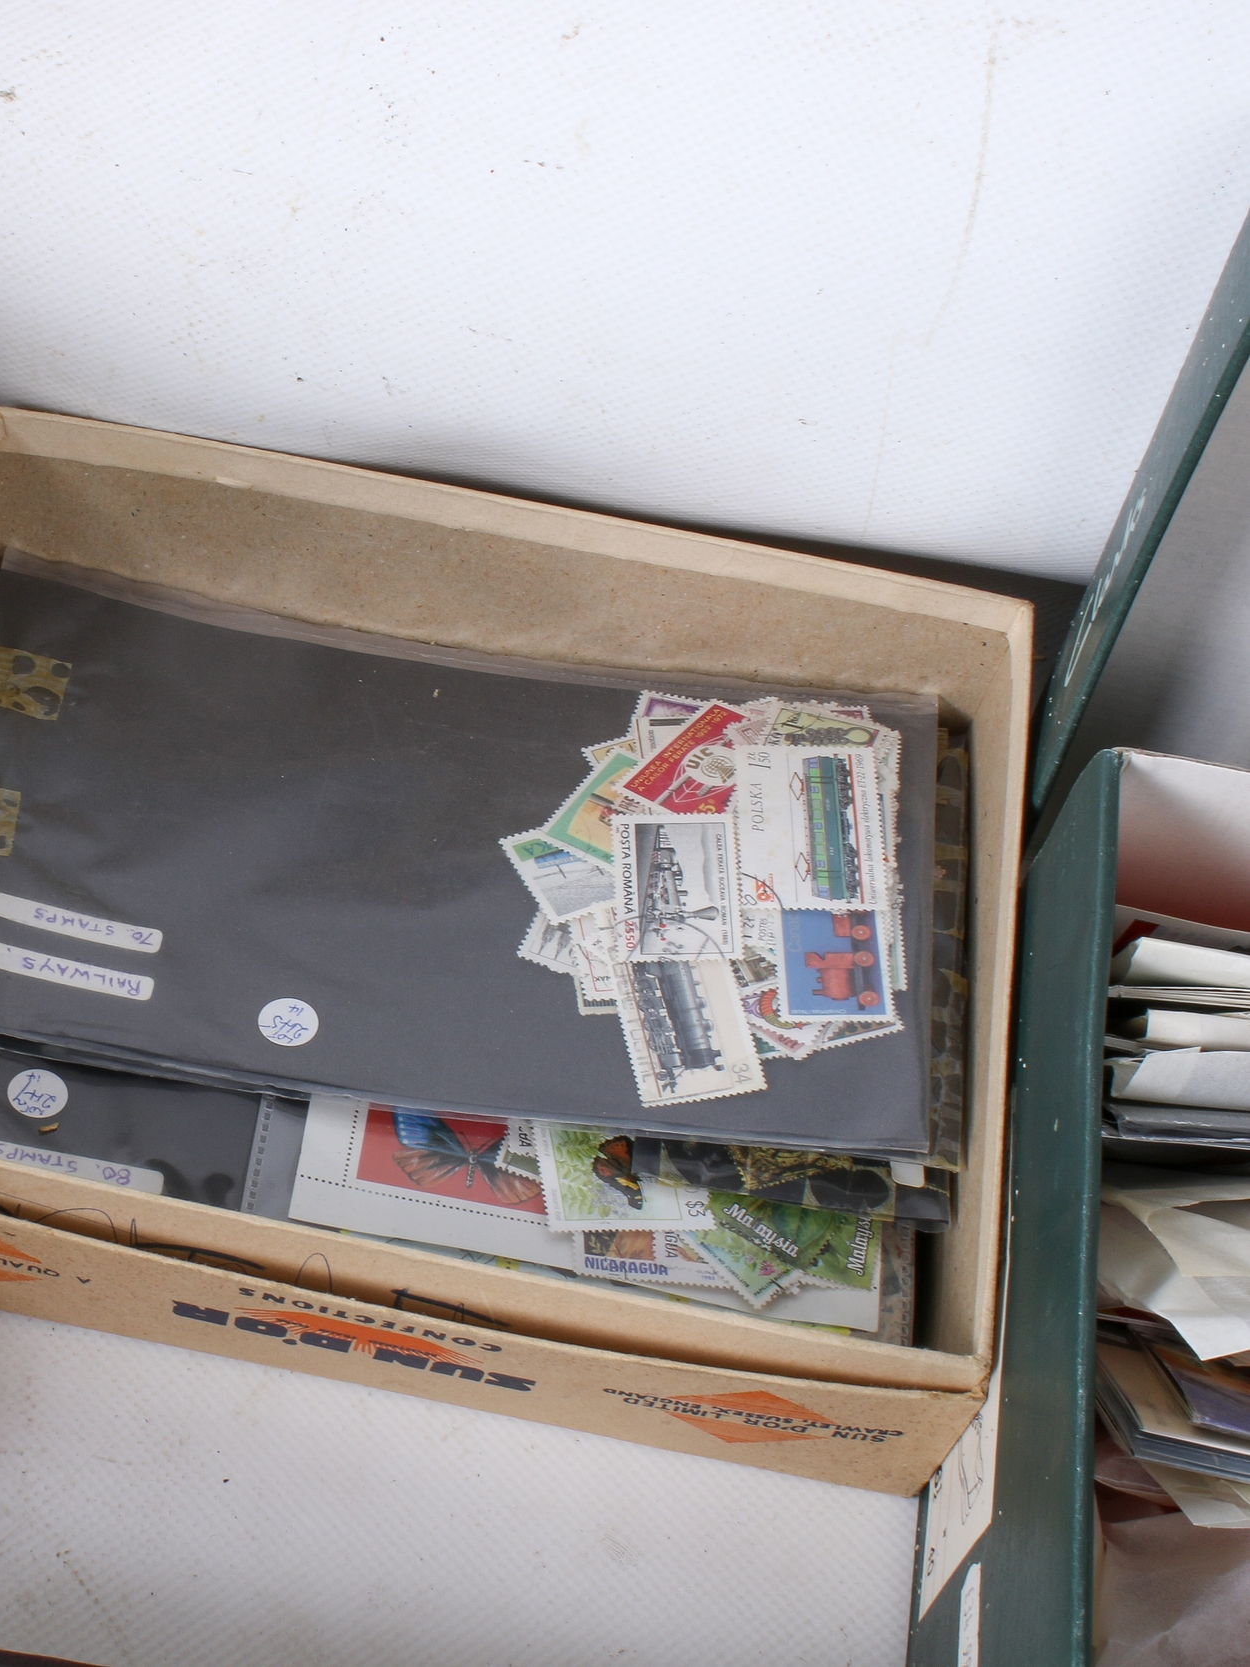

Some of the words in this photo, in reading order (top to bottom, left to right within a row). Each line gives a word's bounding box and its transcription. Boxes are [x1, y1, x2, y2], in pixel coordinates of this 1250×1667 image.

[631, 760, 662, 788] UNIUNEA
[662, 708, 721, 759] INTERNATIONALA
[644, 764, 670, 786] CAILOR
[668, 740, 696, 764] FERATE
[686, 747, 714, 770] UIC
[752, 782, 765, 833] POLSKA
[861, 823, 875, 863] lokomotywa
[865, 862, 878, 905] Uniwersalna
[33, 906, 115, 937] STAMPS
[757, 917, 768, 942] POSTES
[583, 1255, 670, 1278] NICARAGUA
[171, 1300, 351, 1355] D'OR
[238, 1286, 504, 1354] CONFECTIONS
[373, 1344, 537, 1393] SUN
[602, 1387, 702, 1410] ENGLAND
[622, 1396, 723, 1421] LIMITED
[830, 1428, 887, 1444] SUN
